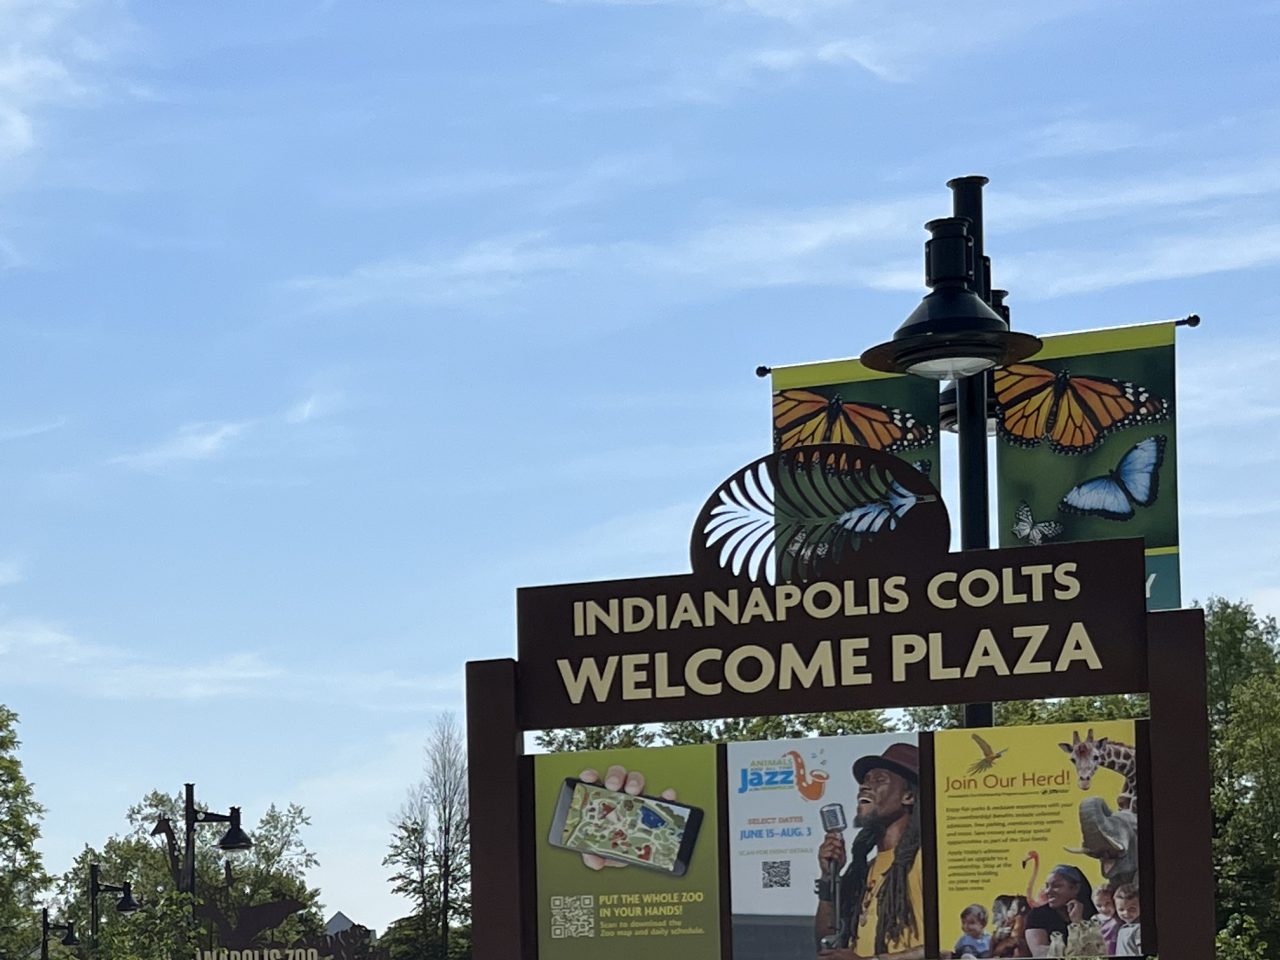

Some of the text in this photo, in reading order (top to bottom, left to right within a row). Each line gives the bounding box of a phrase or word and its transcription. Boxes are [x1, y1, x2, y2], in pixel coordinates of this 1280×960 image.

[573, 562, 1082, 636] INDIANAPOLIS COLTS
[556, 621, 1104, 704] WELCOME PLAZA
[750, 759, 793, 767] ANIMALS
[944, 769, 1070, 792] Join Our Herd!
[740, 829, 763, 840] JUNE
[806, 826, 812, 837] 3
[599, 892, 704, 905] PUT THE WHOLE ZOO
[600, 905, 683, 918] IN YOUR HANDS!
